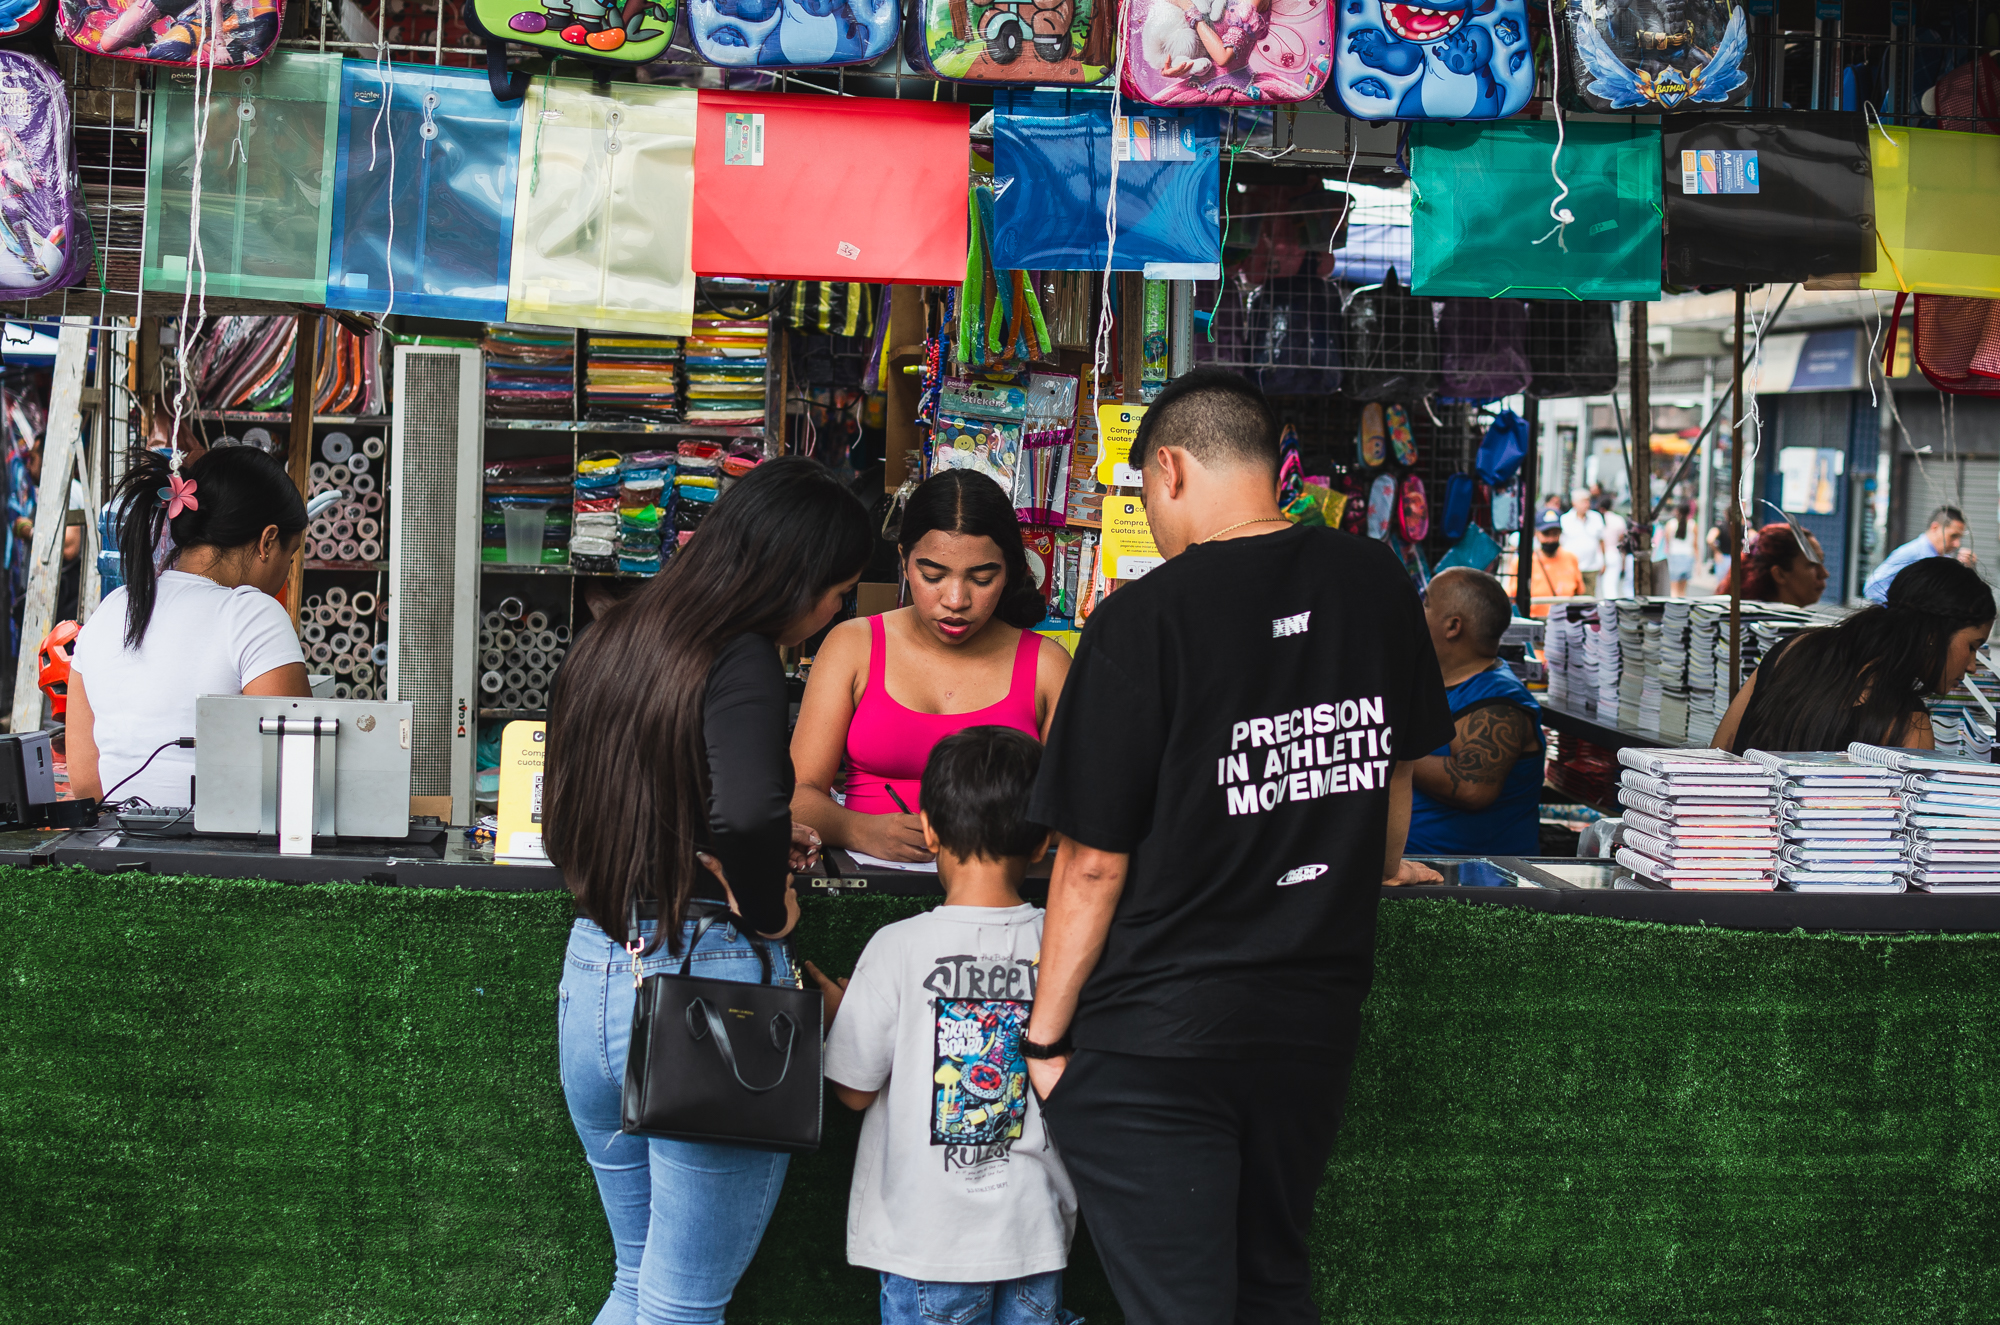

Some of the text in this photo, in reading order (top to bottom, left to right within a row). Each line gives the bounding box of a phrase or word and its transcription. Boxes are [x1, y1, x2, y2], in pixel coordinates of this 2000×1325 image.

[1655, 84, 1686, 94] BATMAN
[1158, 118, 1167, 132] A4
[1723, 151, 1732, 165] A4
[961, 395, 1007, 408] Stickers
[1033, 524, 1053, 535] Tape
[1114, 519, 1144, 527] Compra
[457, 697, 468, 738] DEGAR
[1231, 696, 1384, 751] PRECISION
[521, 749, 546, 758] Comp
[1218, 726, 1392, 785] IN ATHLETIC
[1226, 760, 1389, 816] MOVEMENT
[938, 1017, 983, 1039] SKATE
[937, 1036, 984, 1057] BOARD
